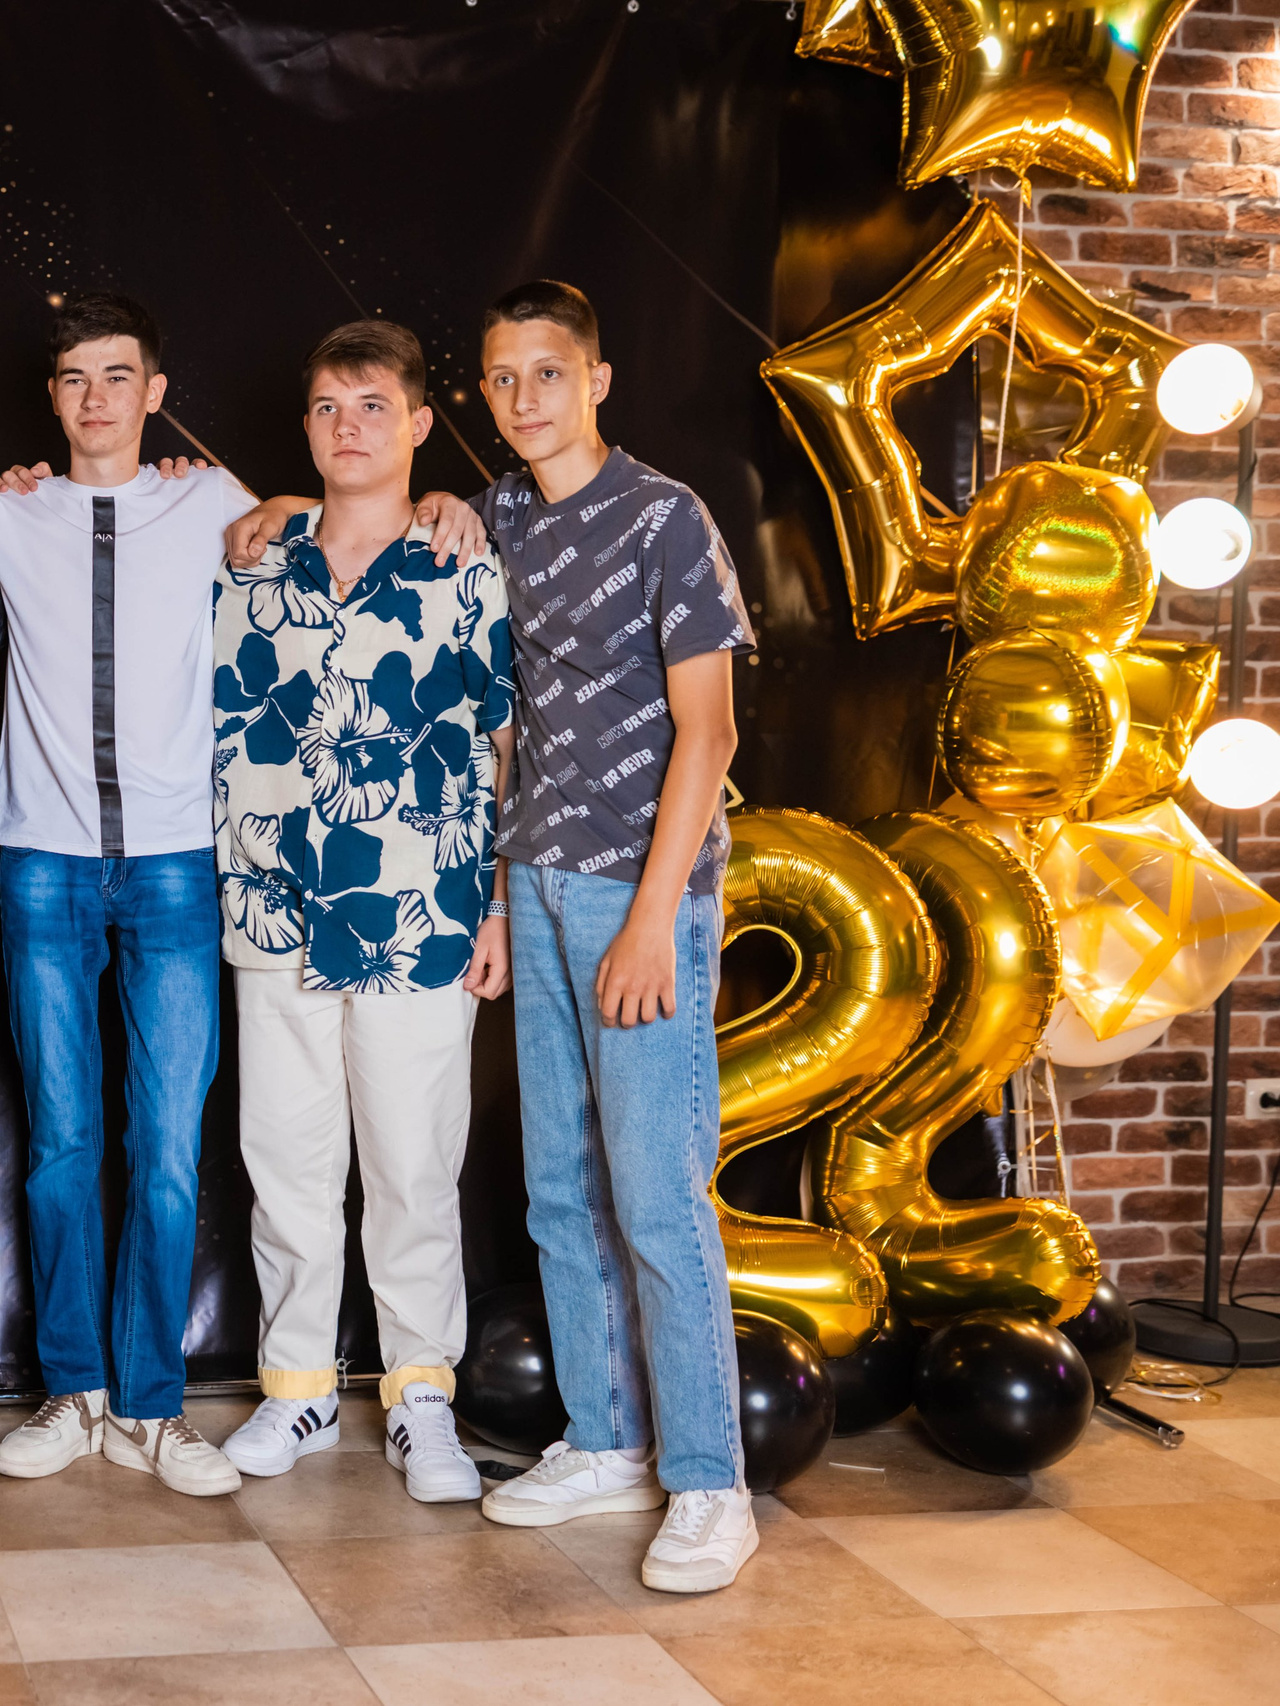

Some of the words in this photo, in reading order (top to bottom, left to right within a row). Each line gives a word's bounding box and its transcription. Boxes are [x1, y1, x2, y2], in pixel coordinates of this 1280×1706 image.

[528, 571, 547, 587] OR
[547, 546, 578, 579] NEVER
[594, 541, 619, 567] NOW
[682, 557, 711, 588] NOW
[567, 599, 593, 625] NOW
[590, 587, 606, 608] OR
[602, 562, 638, 597] NEVER
[603, 629, 628, 655] NOW
[624, 618, 646, 635] OR
[612, 655, 642, 681] NOW
[534, 678, 564, 709] NEVER
[597, 723, 626, 749] NOW
[622, 714, 642, 733] OR
[637, 697, 670, 723] NEER
[556, 761, 579, 786] NOW
[601, 768, 621, 790] OR
[617, 748, 656, 779] NEVER
[503, 797, 514, 815] OR
[546, 811, 563, 827] OR
[577, 847, 620, 874] NEVER
[414, 1394, 446, 1403] adidas
